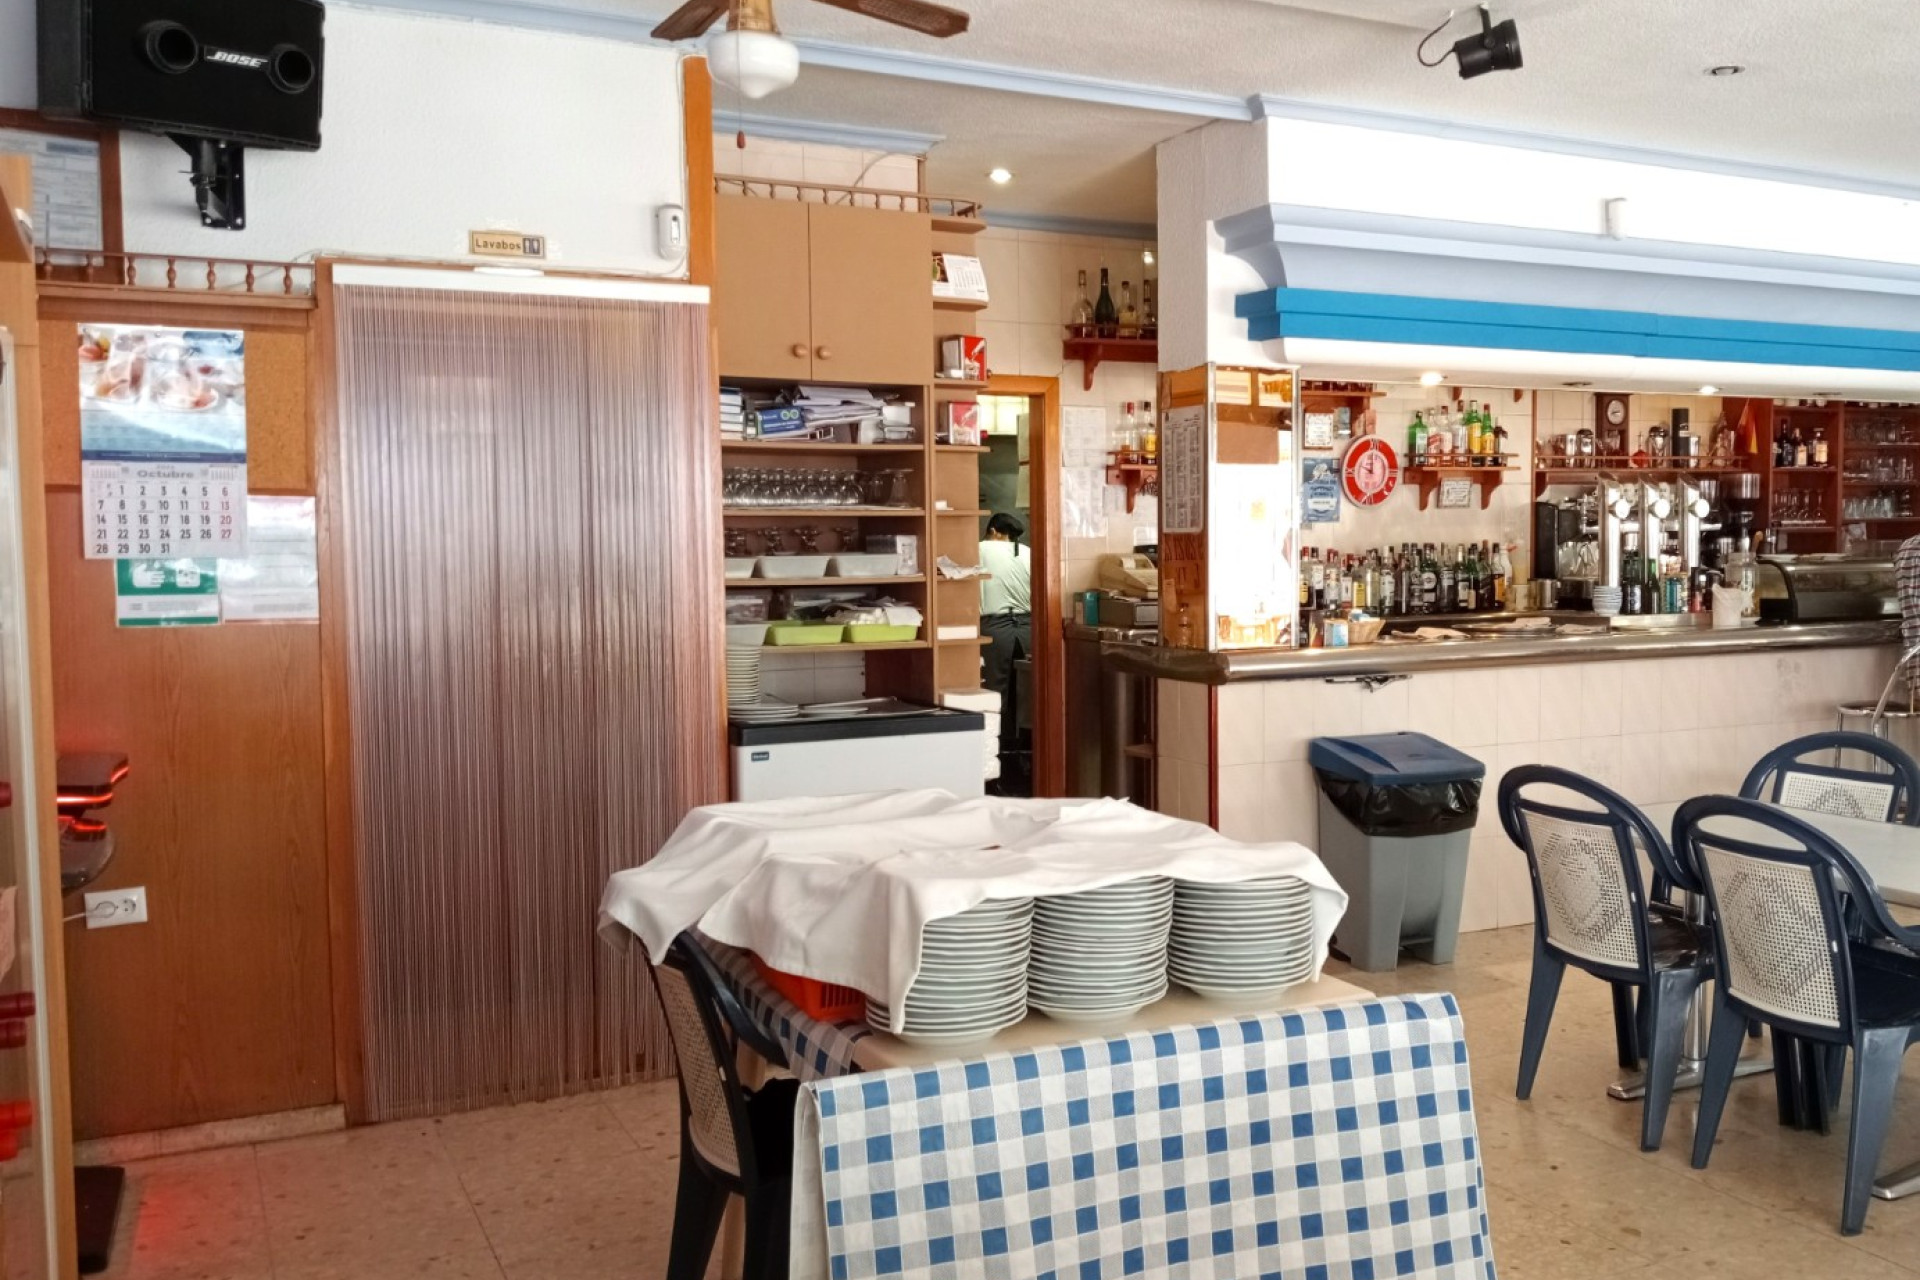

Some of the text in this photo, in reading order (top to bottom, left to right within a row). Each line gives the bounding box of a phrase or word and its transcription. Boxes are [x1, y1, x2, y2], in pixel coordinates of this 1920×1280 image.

[206, 51, 269, 67] BOSE
[475, 238, 522, 250] Lavabos
[137, 469, 194, 479] Octubre
[120, 484, 229, 497] 1 2 3 4 5 6
[98, 499, 230, 511] 7 8 9 10 11 12 13
[97, 514, 232, 525] 14 15 16 17 18 19 20
[97, 528, 232, 540] 21 22 23 24 25 26 27
[96, 542, 170, 554] 28 29 30 31
